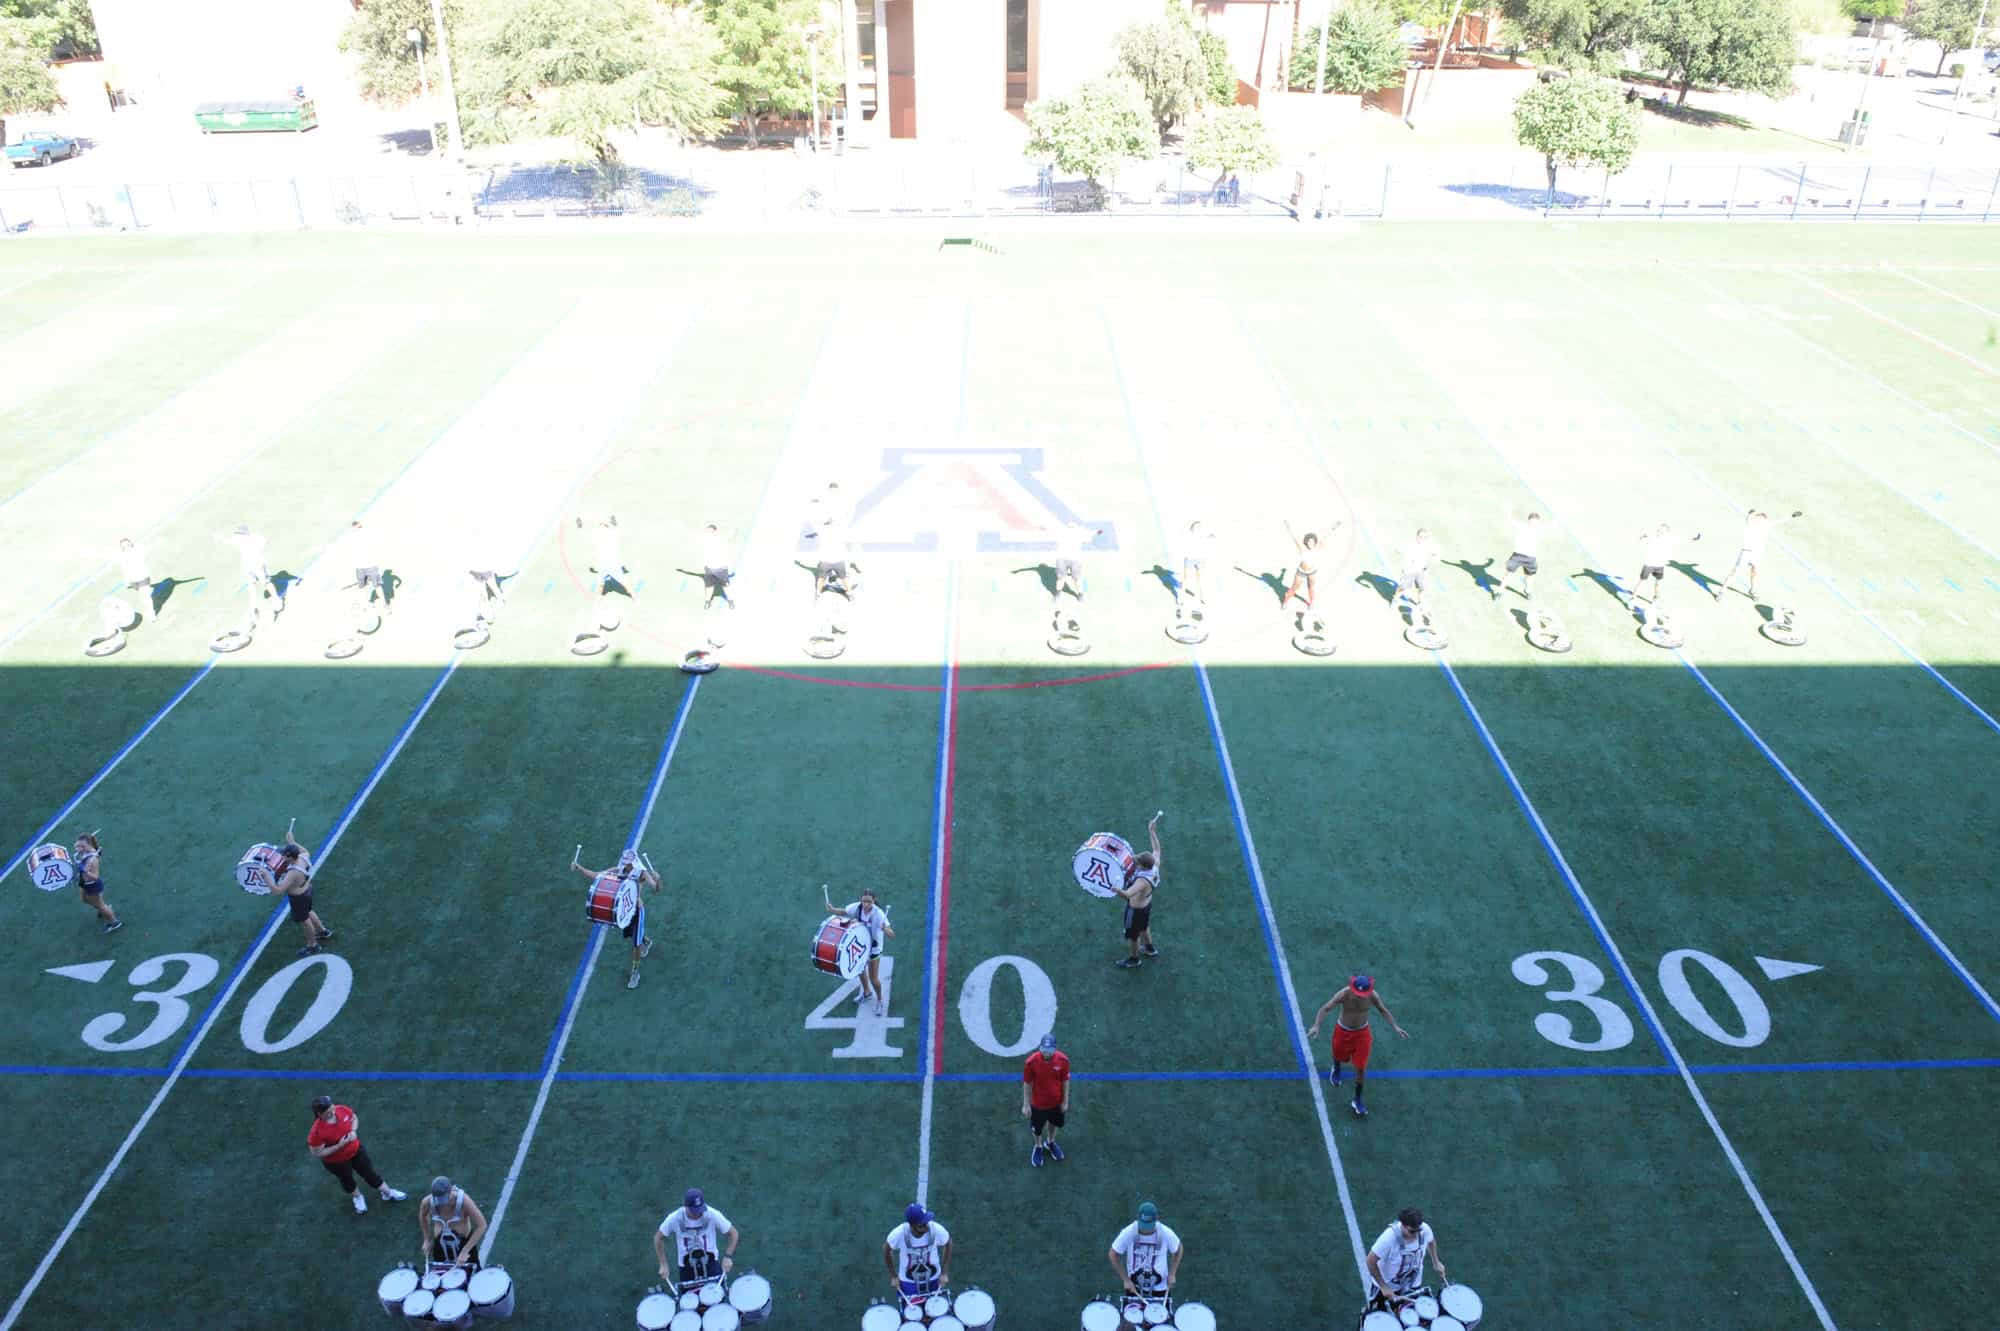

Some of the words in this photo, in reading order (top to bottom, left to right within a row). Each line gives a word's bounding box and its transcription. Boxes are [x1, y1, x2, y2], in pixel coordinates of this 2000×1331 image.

[796, 448, 1118, 552] A
[41, 864, 67, 885] A
[244, 867, 268, 886] A
[1082, 857, 1112, 890] A
[619, 887, 634, 921] A
[847, 935, 867, 972] A
